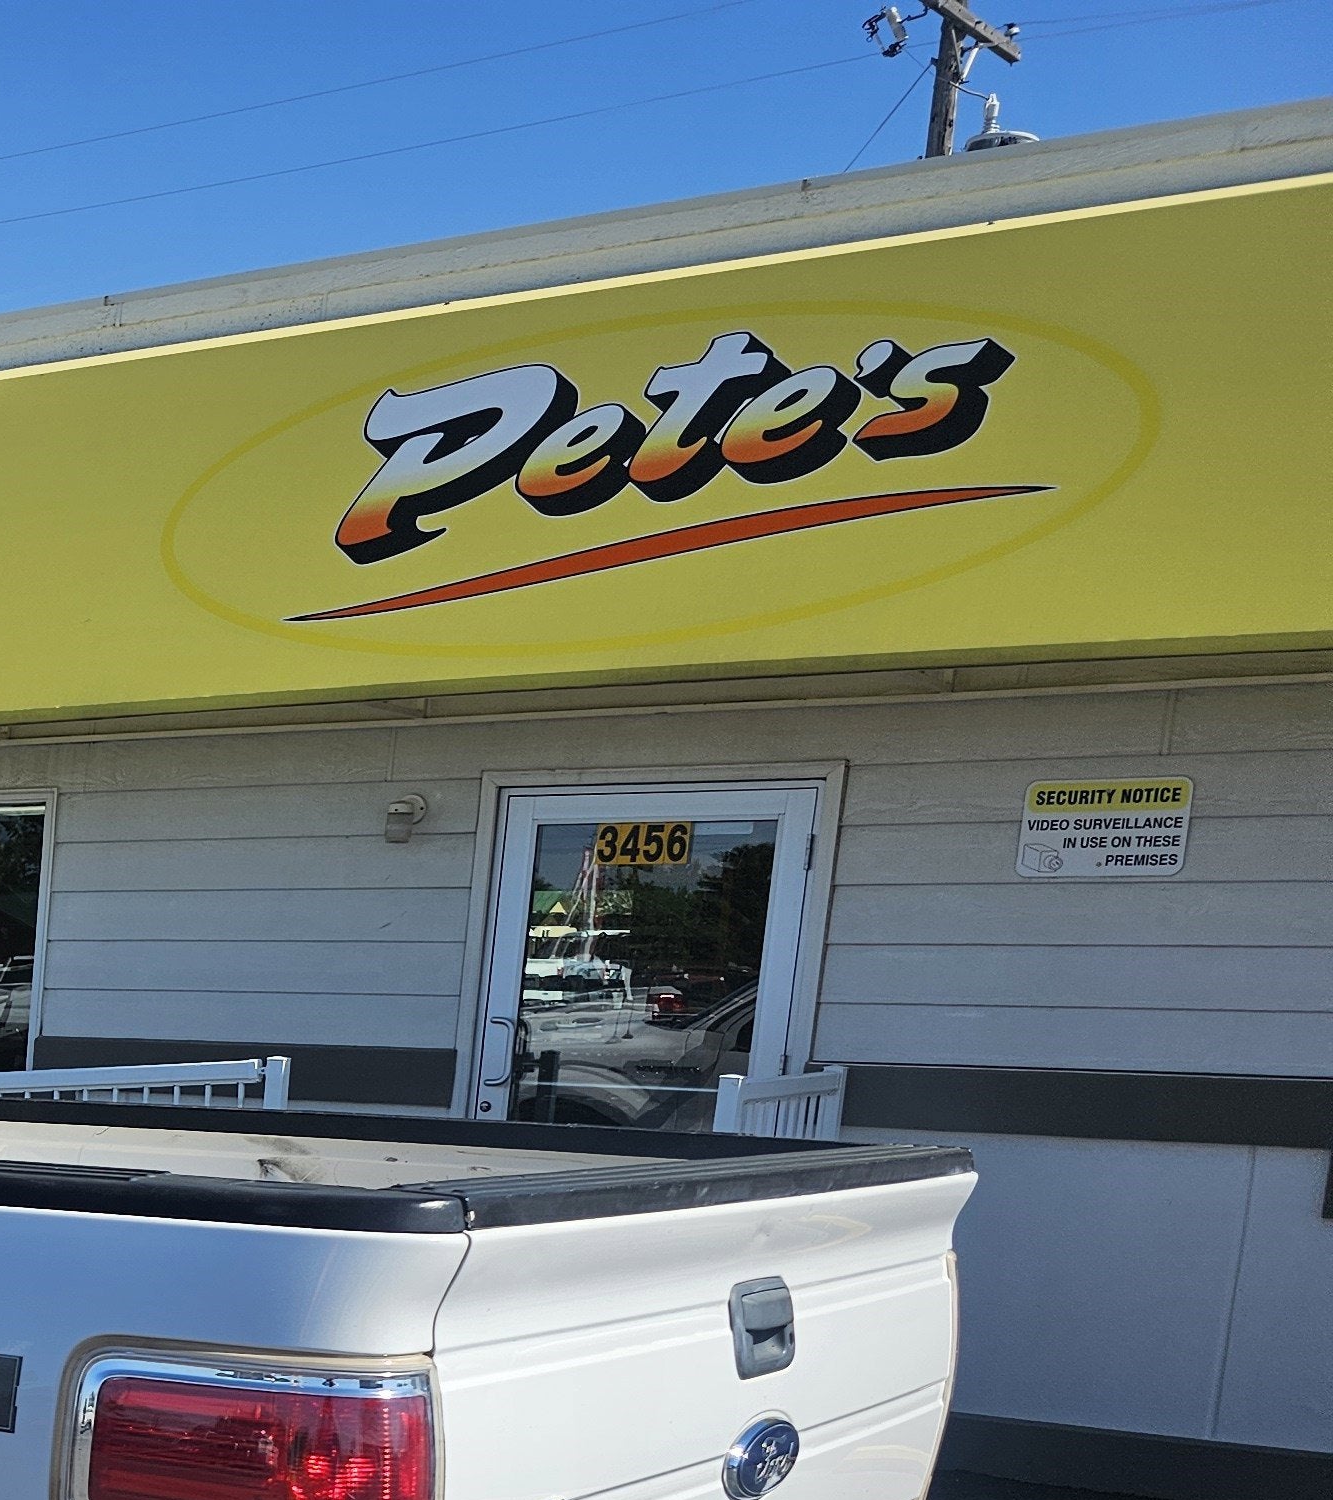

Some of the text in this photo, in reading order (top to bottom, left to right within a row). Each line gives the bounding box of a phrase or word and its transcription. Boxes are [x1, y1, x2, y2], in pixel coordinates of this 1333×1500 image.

[335, 332, 1015, 565] Pete's
[1035, 787, 1182, 806] SECURITY NOTICE
[1028, 817, 1183, 831] VIDEO SURVEILLANCE
[597, 823, 688, 863] 3456
[1062, 835, 1181, 849] IN USE ON THESE
[1105, 854, 1178, 866] PREMISES
